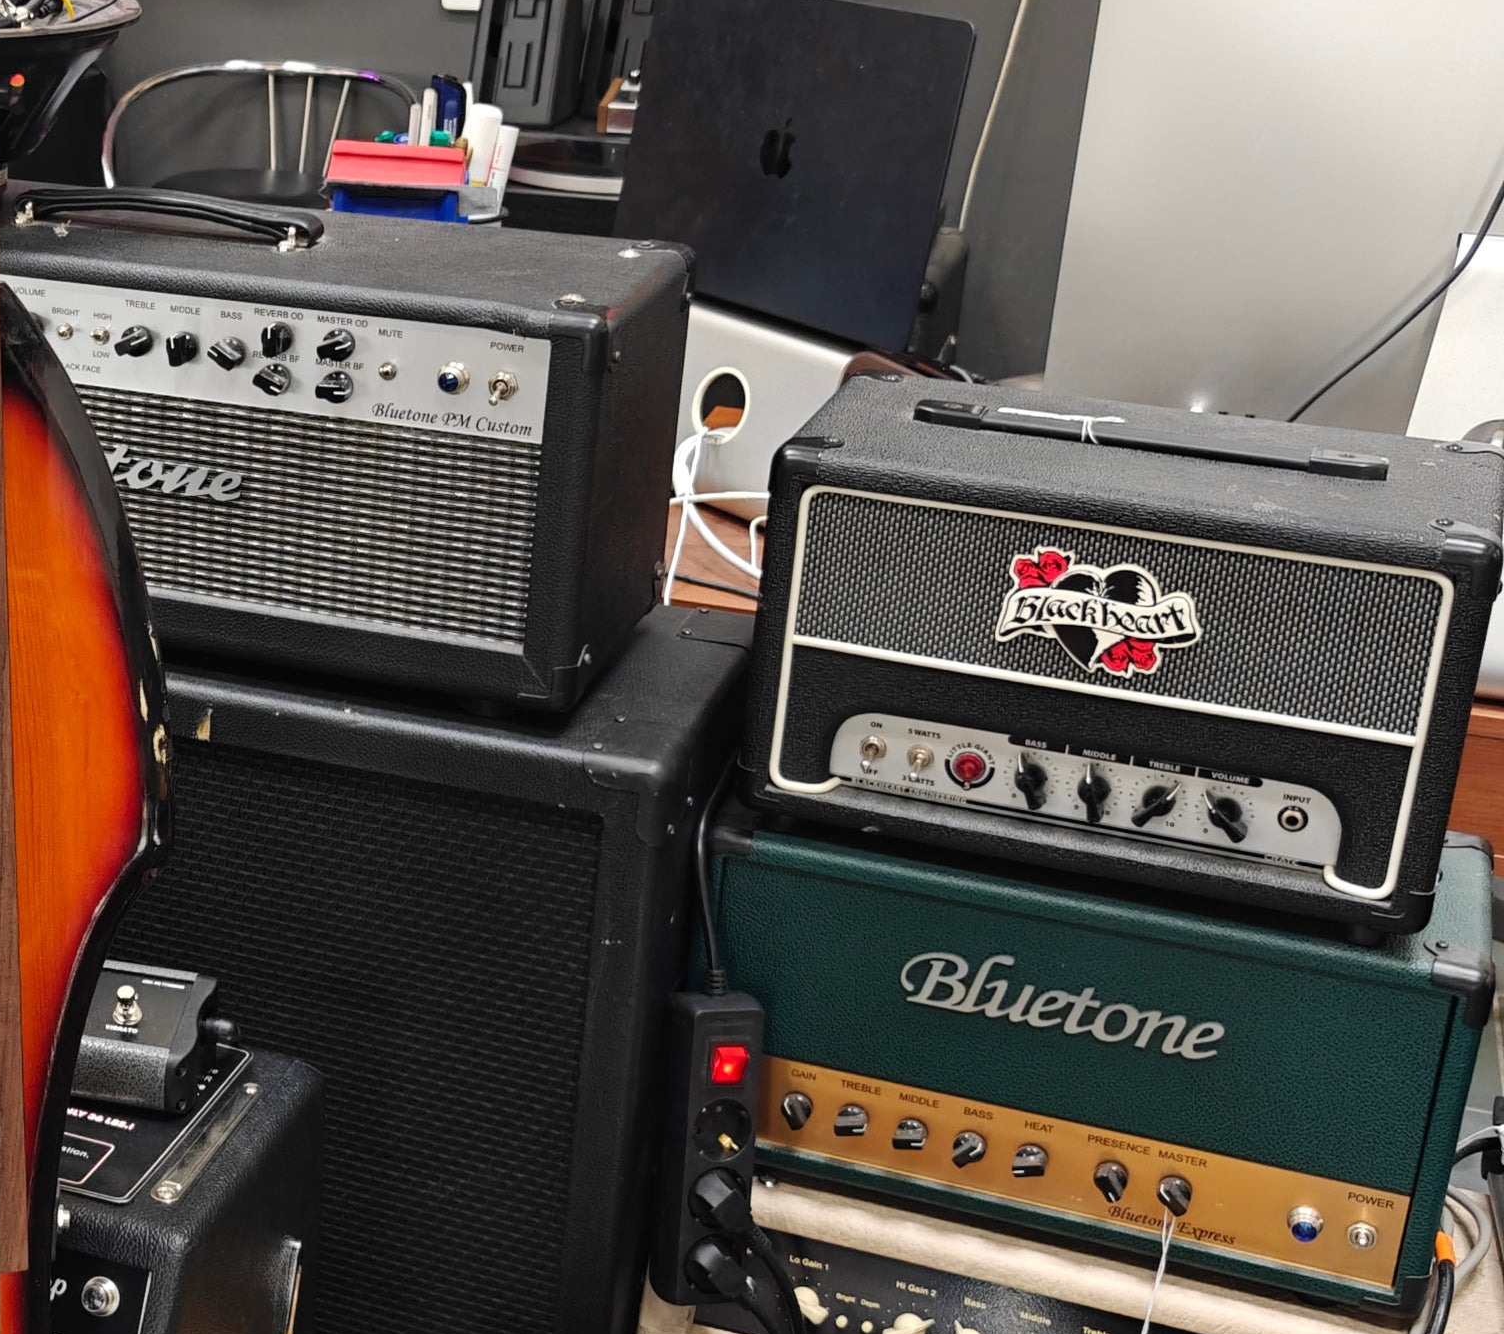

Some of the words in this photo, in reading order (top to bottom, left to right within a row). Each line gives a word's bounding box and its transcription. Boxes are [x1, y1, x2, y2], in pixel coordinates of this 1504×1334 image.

[13, 286, 46, 298] VOLUME
[124, 299, 156, 310] TREBLE
[169, 305, 201, 316] MIDDLE
[51, 307, 80, 317] BRIGHT
[93, 312, 112, 321] HIGH
[220, 310, 243, 320] BASS
[254, 307, 285, 319] REVERB
[286, 312, 304, 321] OD
[317, 315, 353, 327] MASTER
[354, 319, 368, 328] OD
[378, 328, 403, 339] MUTE
[490, 341, 525, 353] POWER
[92, 350, 111, 359] LOW
[65, 363, 81, 372] ACK
[81, 364, 102, 374] FACE
[315, 358, 351, 370] MASTER
[372, 403, 438, 425] Bluetone
[442, 410, 471, 429] PM
[475, 417, 533, 437] Custom
[104, 444, 242, 501] tone
[1012, 595, 1186, 634] Blackheart
[870, 721, 882, 729] ON
[914, 729, 941, 739] WATTS
[1025, 738, 1046, 749] BASS
[947, 742, 972, 760] LITTLE
[974, 744, 995, 766] GIANT
[1082, 748, 1116, 761] MIDDLE
[1148, 760, 1181, 773] TREBLE
[1211, 772, 1250, 785] VOLUME
[1283, 793, 1312, 804] INPUT
[901, 951, 1226, 1060] Bluetone
[791, 1068, 817, 1081] GAIN
[841, 1079, 882, 1096] TREBLE
[899, 1092, 939, 1109] MIDDLE
[964, 1106, 993, 1120] BASS
[1024, 1120, 1055, 1134] HEAT
[1087, 1133, 1151, 1155] PRESENCE
[1158, 1149, 1207, 1168] MASTER
[1348, 1192, 1394, 1210] POWER
[1107, 1205, 1172, 1229] Blueton
[1177, 1218, 1236, 1245] Express
[789, 1254, 800, 1263] Lo
[802, 1257, 823, 1269] Gain
[896, 1280, 907, 1289] Hi
[908, 1284, 930, 1296] Gain
[964, 1297, 986, 1310] Bass
[1020, 1311, 1051, 1326] Middle
